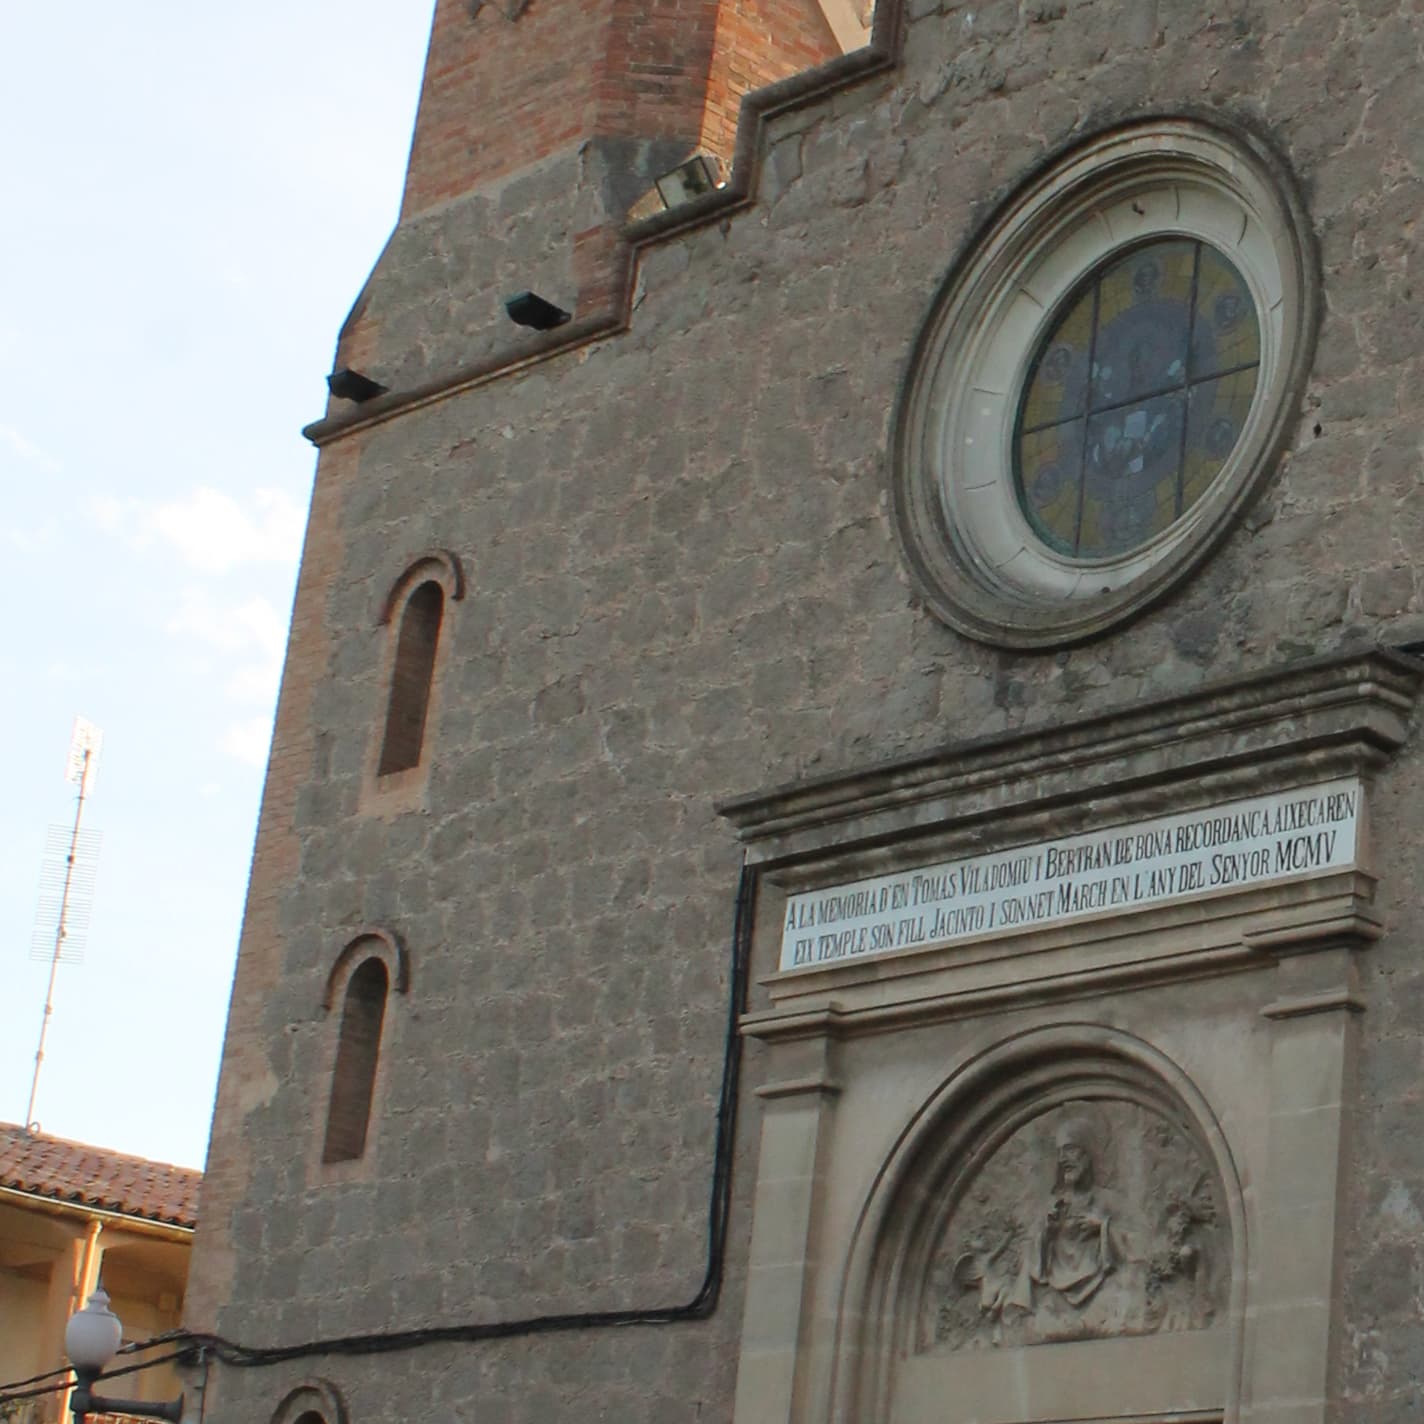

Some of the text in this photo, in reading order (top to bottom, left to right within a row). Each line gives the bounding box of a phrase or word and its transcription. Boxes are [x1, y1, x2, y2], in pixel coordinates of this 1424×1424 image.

[786, 901, 796, 931] A
[798, 900, 815, 928] LA
[817, 889, 877, 924] MEMORIA
[911, 873, 957, 906] TOMAS
[960, 855, 1033, 896] VILADOMIU
[1035, 856, 1042, 882] I
[1045, 838, 1114, 880] BERTRAN
[1114, 837, 1134, 865] DE
[1135, 828, 1172, 862] BONA
[1271, 790, 1356, 835] AIXECAREN
[793, 938, 812, 965] EIX
[817, 927, 868, 961] TEMPLE
[869, 920, 898, 951] SON
[898, 916, 926, 946] FILL
[929, 904, 985, 939] JACINTO
[988, 902, 996, 929] I
[1000, 889, 1056, 926] SONNET
[1057, 879, 1108, 916] MARCH
[1111, 875, 1130, 905] EN
[1178, 861, 1205, 893] DEL
[1210, 848, 1271, 886] SENYOR
[1275, 829, 1337, 873] MCMV
